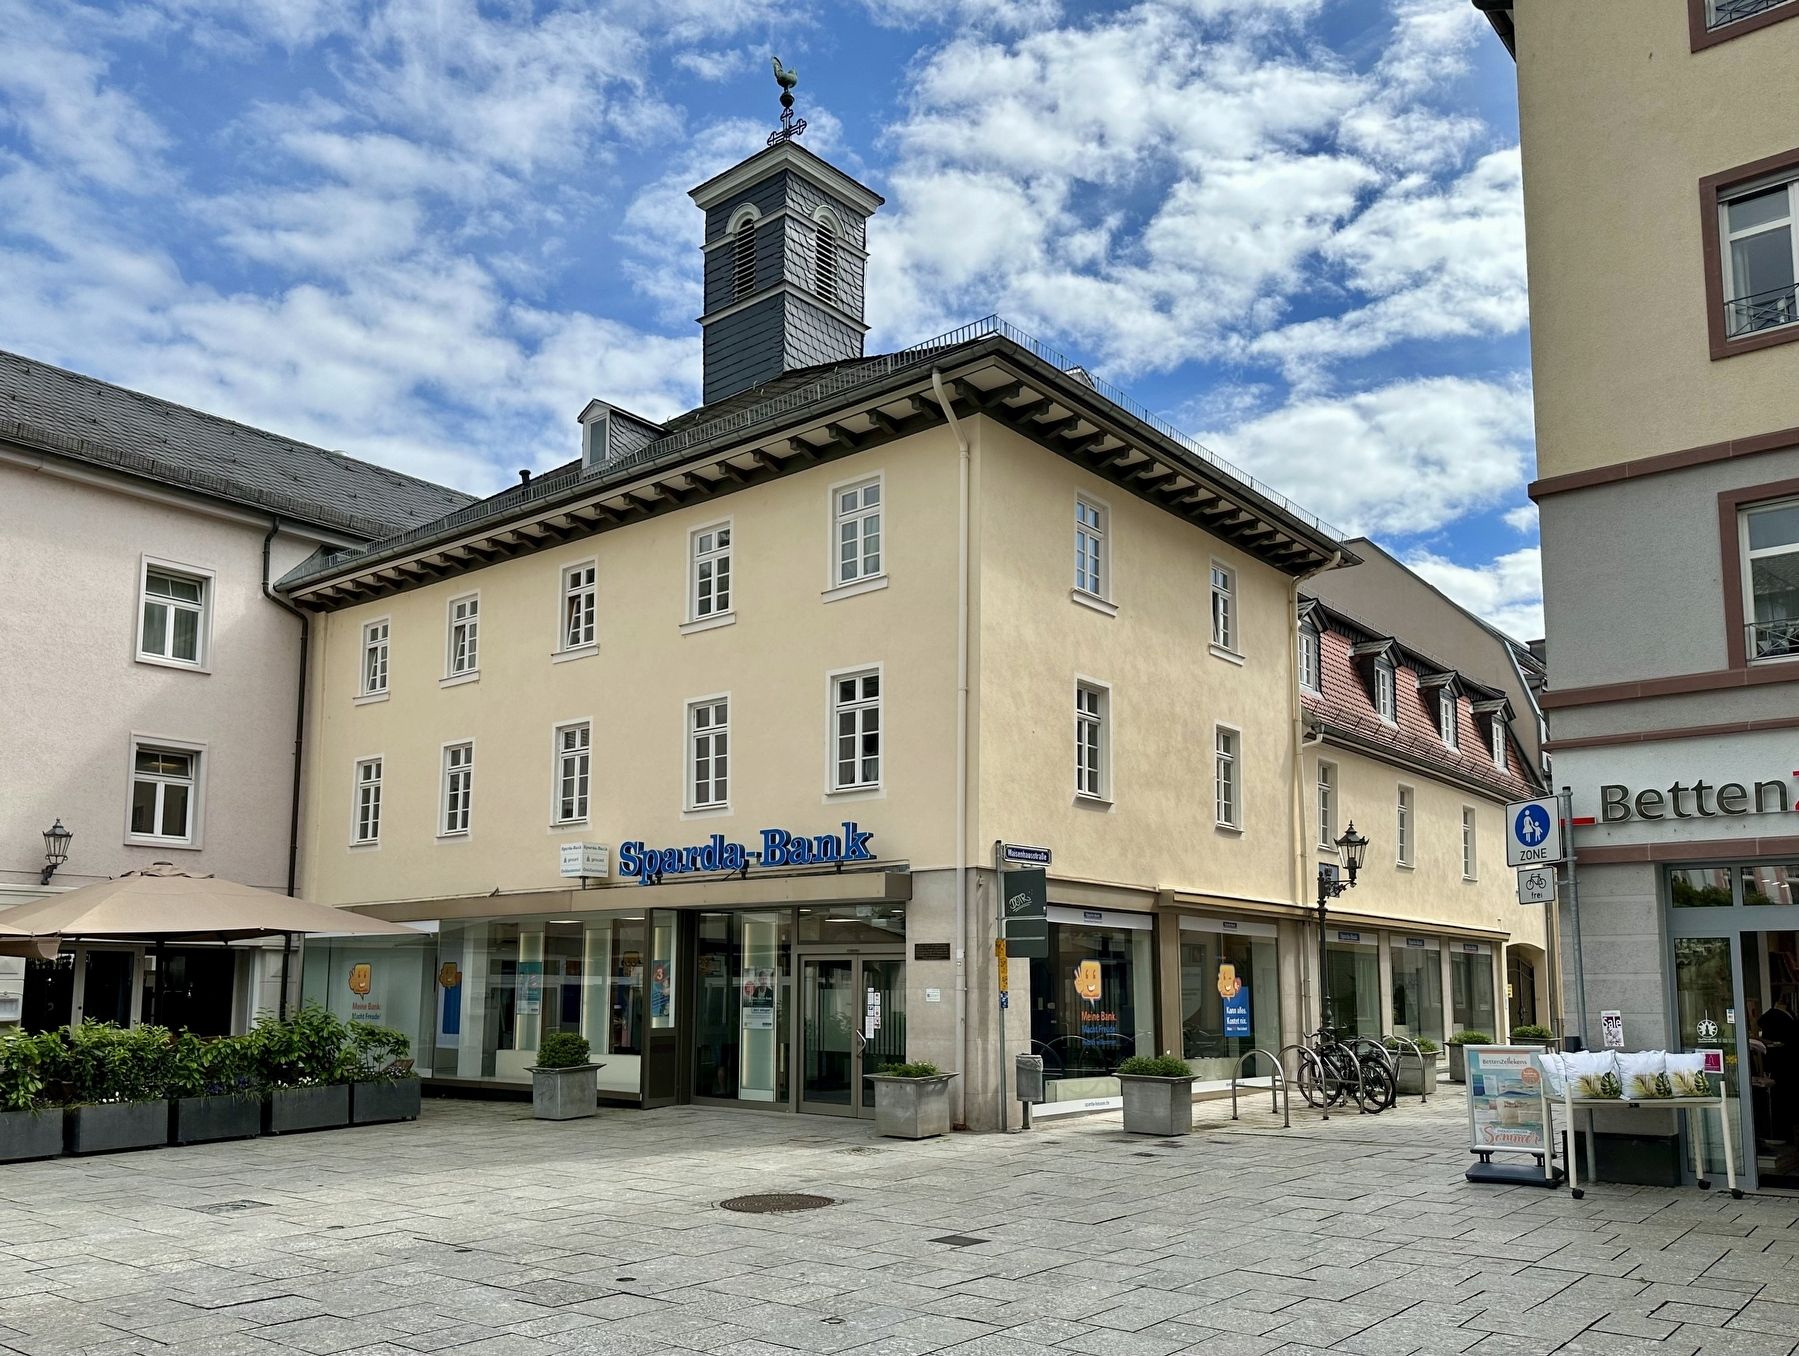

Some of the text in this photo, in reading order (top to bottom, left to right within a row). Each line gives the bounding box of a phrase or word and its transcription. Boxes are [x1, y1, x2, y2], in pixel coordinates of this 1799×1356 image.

[1600, 770, 1799, 823] Betten
[619, 821, 878, 887] Sparda-Bank
[1520, 848, 1547, 861] ZONE
[1081, 1011, 1100, 1021] Meine
[1602, 1016, 1621, 1028] Sale
